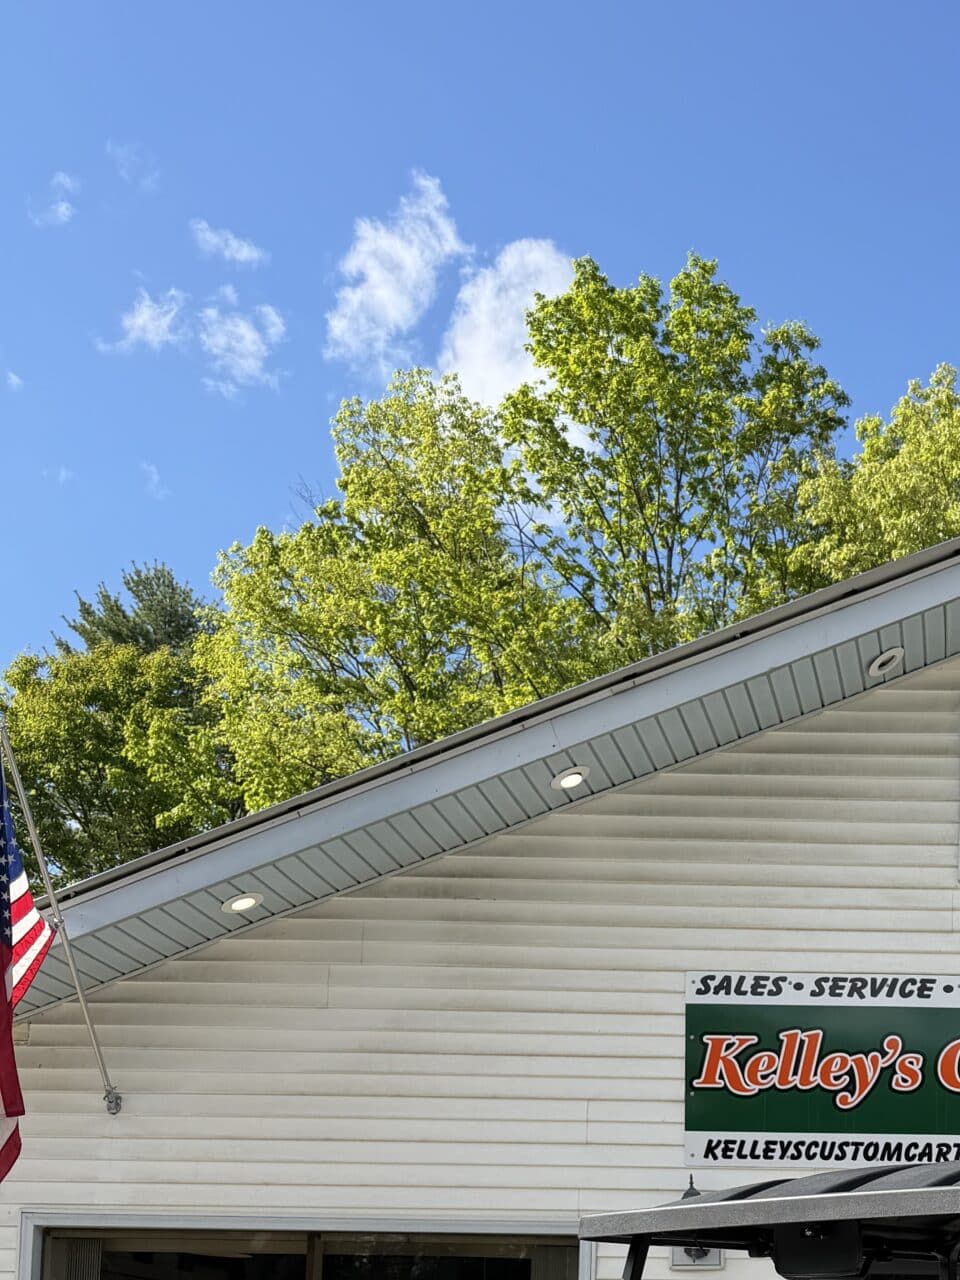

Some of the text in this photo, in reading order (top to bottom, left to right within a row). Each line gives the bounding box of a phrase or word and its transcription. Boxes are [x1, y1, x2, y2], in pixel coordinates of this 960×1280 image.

[695, 974, 787, 996] SALES
[809, 976, 936, 999] SERVICE
[693, 1029, 923, 1109] Kelley's
